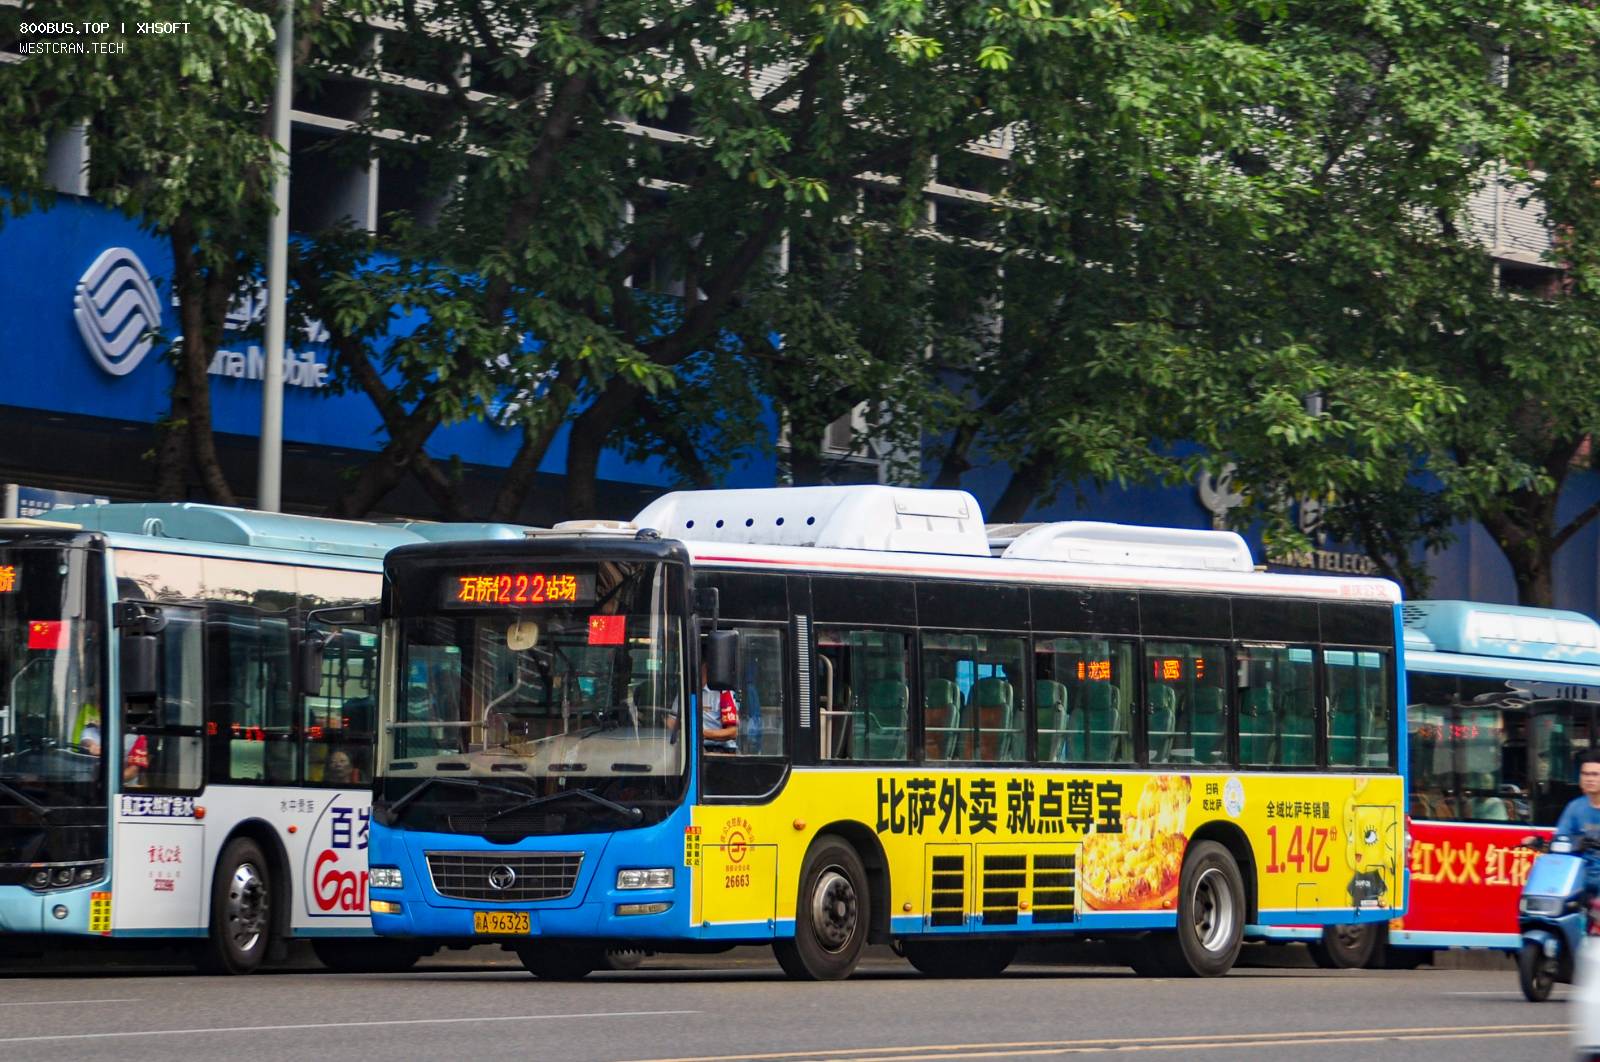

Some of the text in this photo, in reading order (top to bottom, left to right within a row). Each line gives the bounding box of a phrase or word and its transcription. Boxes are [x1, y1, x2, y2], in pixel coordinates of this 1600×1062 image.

[876, 777, 1123, 836] 比萨外卖 就点尊宝
[1202, 799, 1222, 811] 吃比萨
[725, 874, 750, 889] 26663
